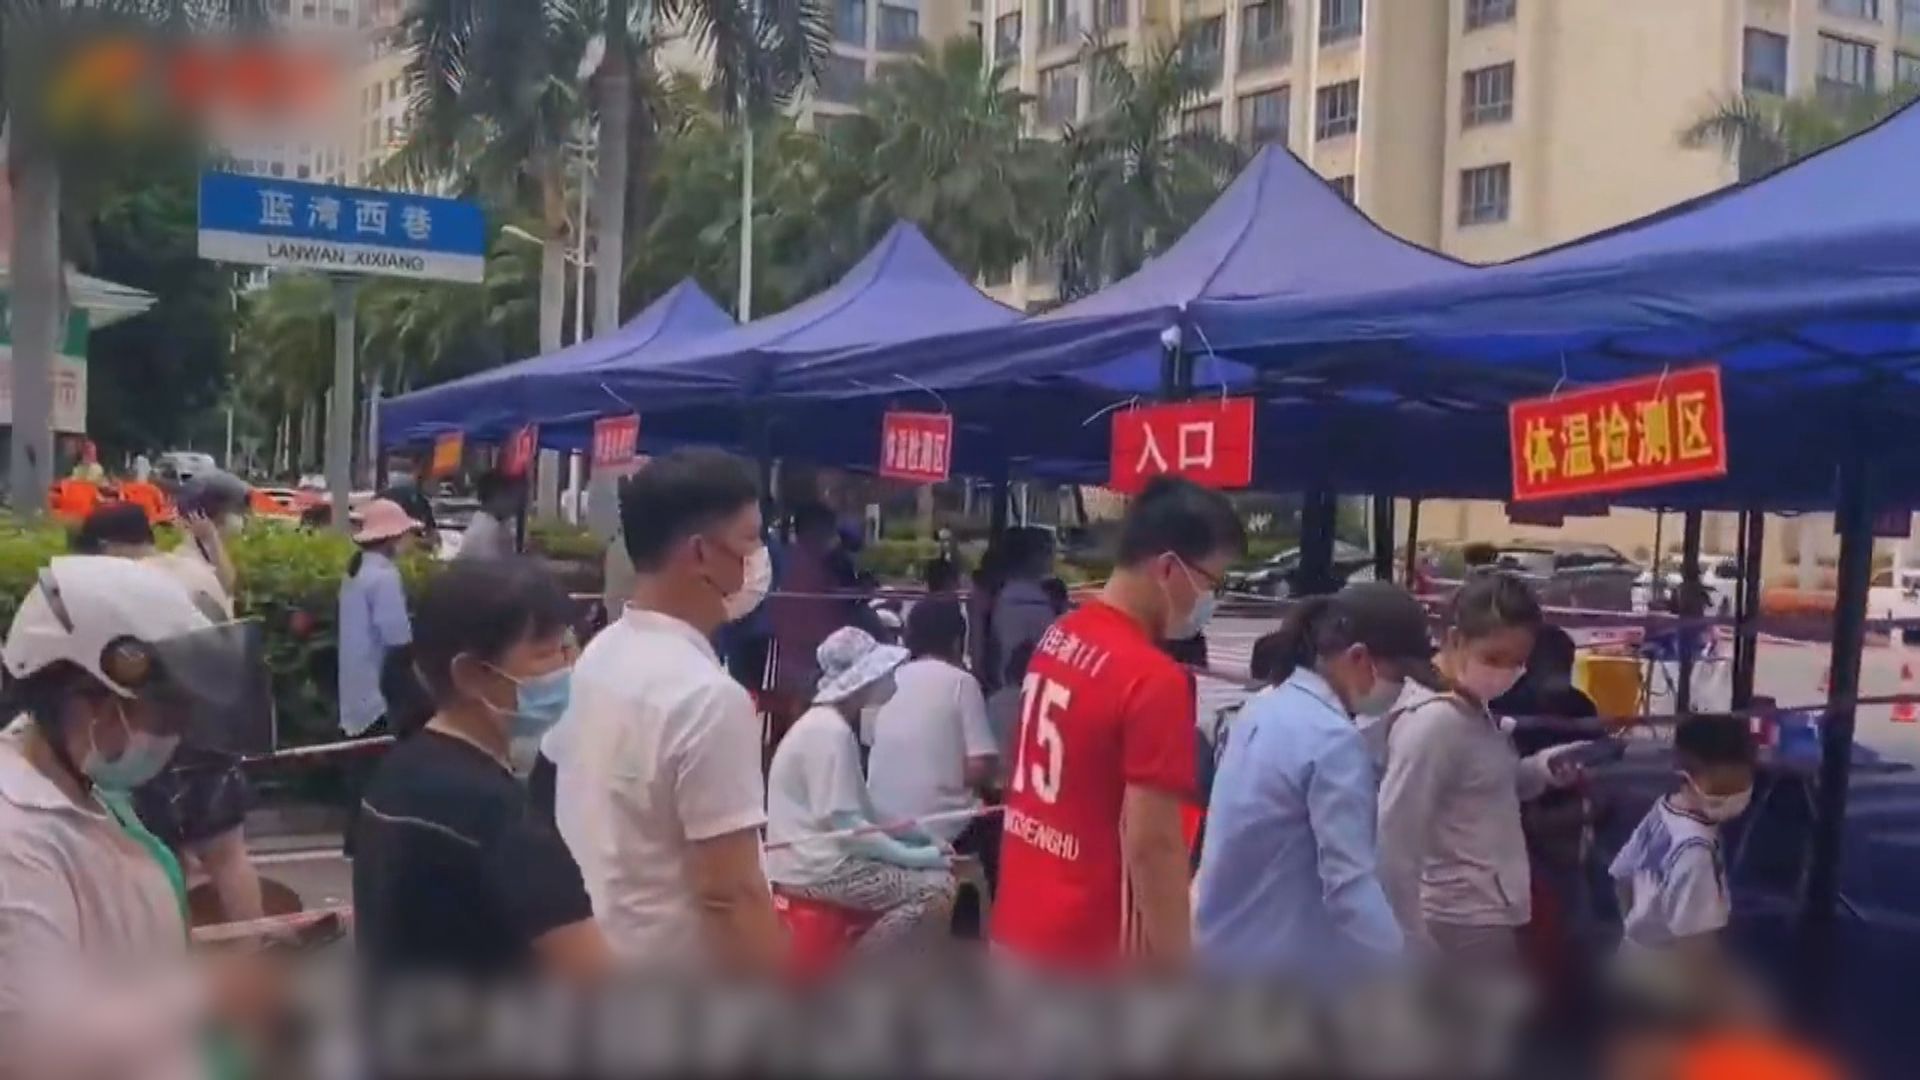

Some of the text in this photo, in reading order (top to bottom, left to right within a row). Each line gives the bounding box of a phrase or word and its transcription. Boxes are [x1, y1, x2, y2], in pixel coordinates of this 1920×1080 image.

[257, 189, 432, 240] 蓝湾西巷
[267, 242, 425, 272] LANWAN XIXIANG
[1136, 421, 1214, 473] 入口
[1523, 391, 1712, 485] 体温检测区
